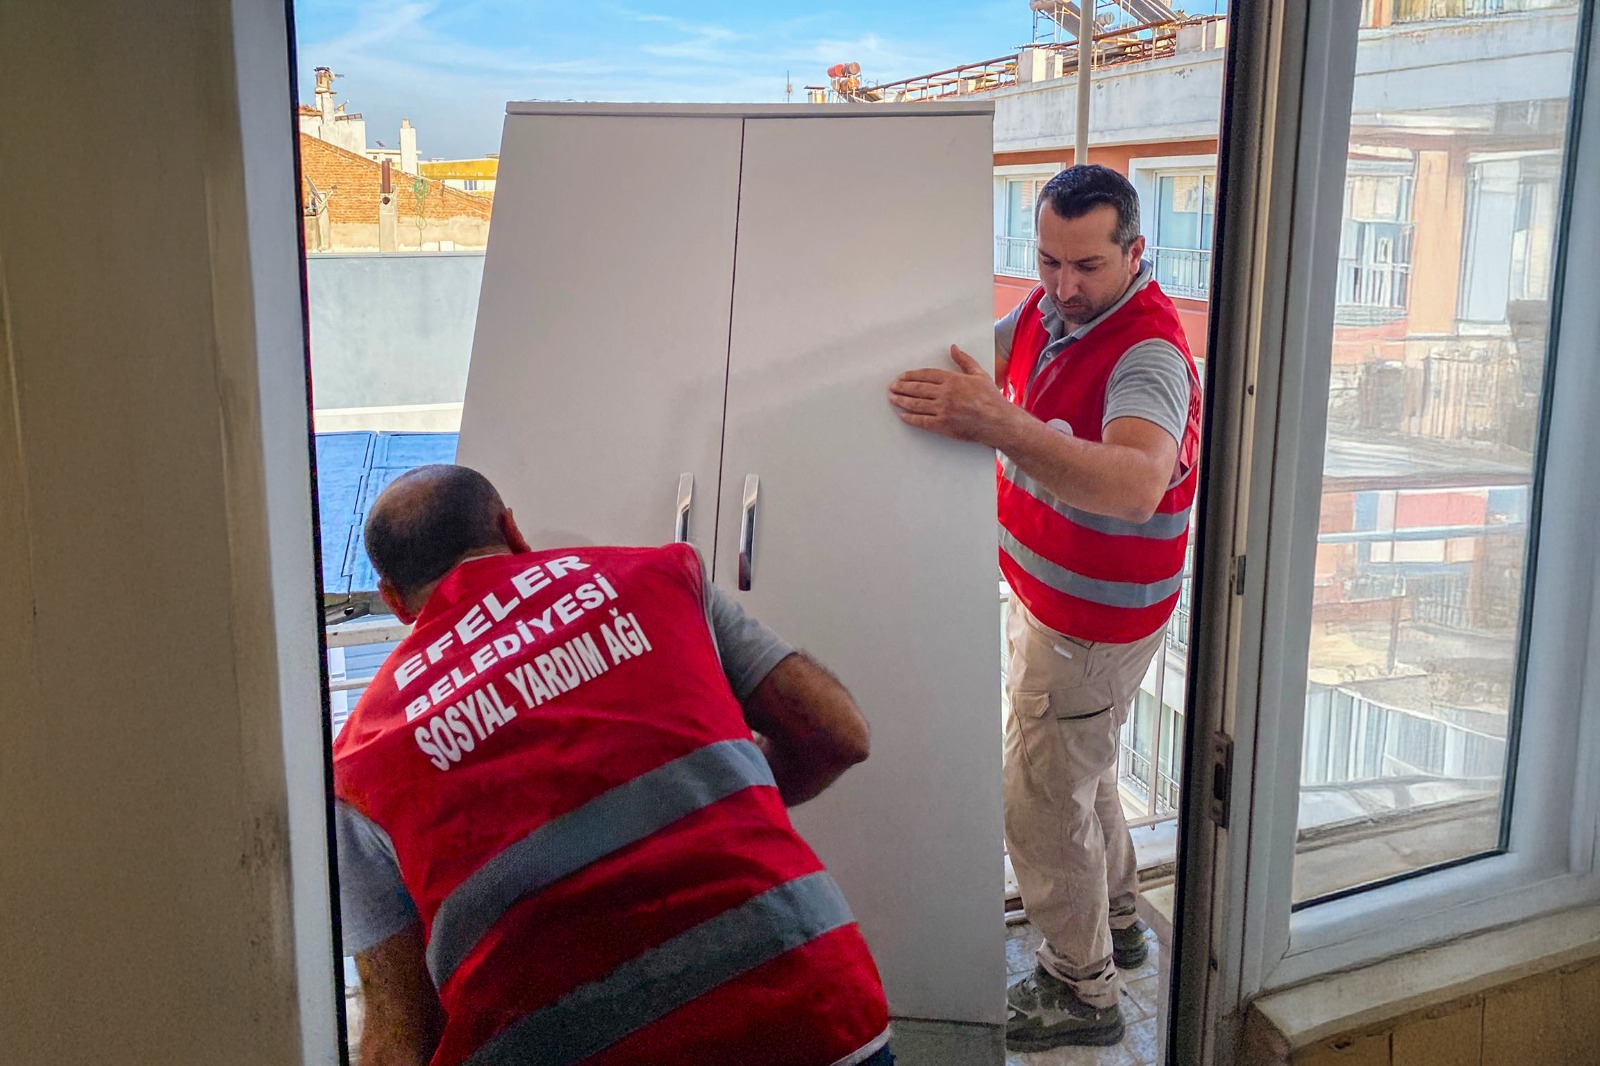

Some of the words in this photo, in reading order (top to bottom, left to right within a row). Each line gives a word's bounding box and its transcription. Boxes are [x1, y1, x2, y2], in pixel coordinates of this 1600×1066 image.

[393, 555, 590, 691] EFELER
[404, 573, 618, 722] BELEDİYESİ
[414, 682, 517, 771] SOSYAL
[505, 632, 609, 709] YARDIM
[599, 607, 652, 666] AĞI
